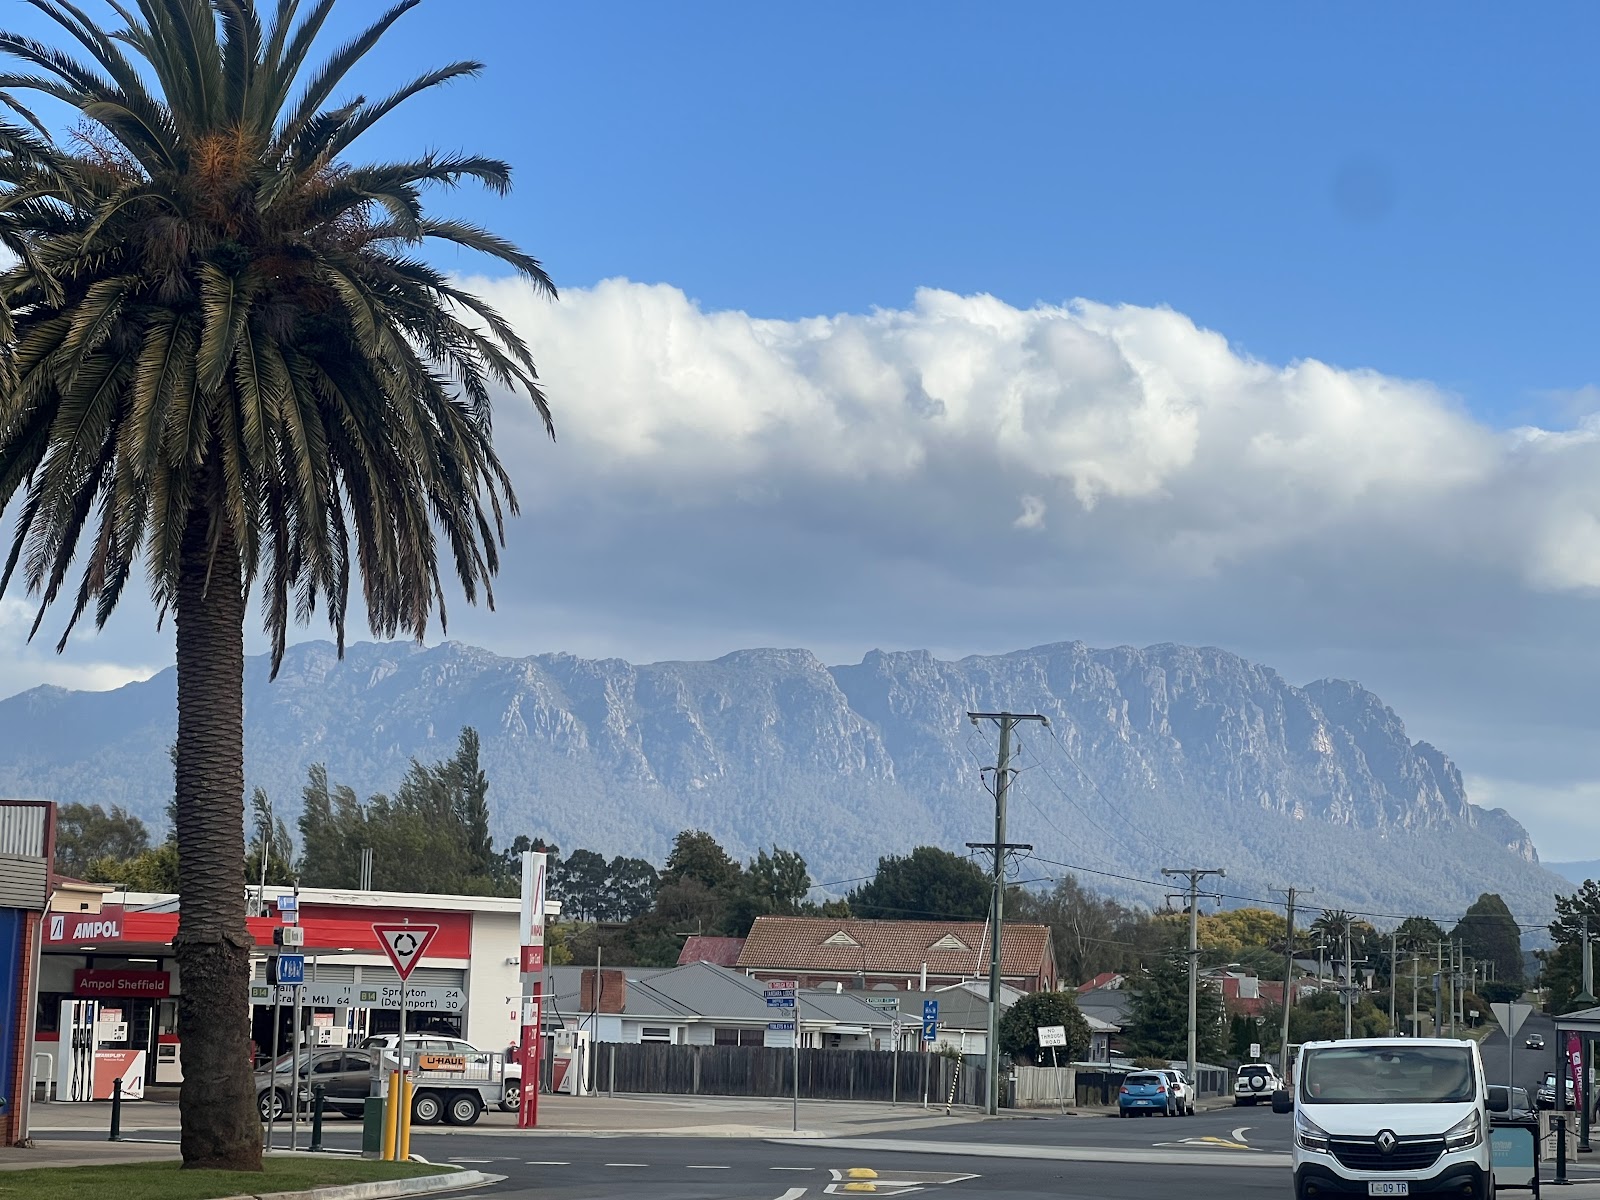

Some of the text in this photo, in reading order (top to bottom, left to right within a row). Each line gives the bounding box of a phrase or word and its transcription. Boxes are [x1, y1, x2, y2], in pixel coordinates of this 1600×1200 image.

[72, 921, 119, 940] AMPOL
[80, 978, 165, 991] Ampol Sheffield
[382, 987, 458, 998] Spryton 24
[312, 995, 329, 1004] Mt)
[336, 997, 350, 1005] 64
[381, 998, 458, 1009] (Devnport) 30
[427, 1057, 463, 1065] U-HAUL
[1396, 1183, 1407, 1193] TR
